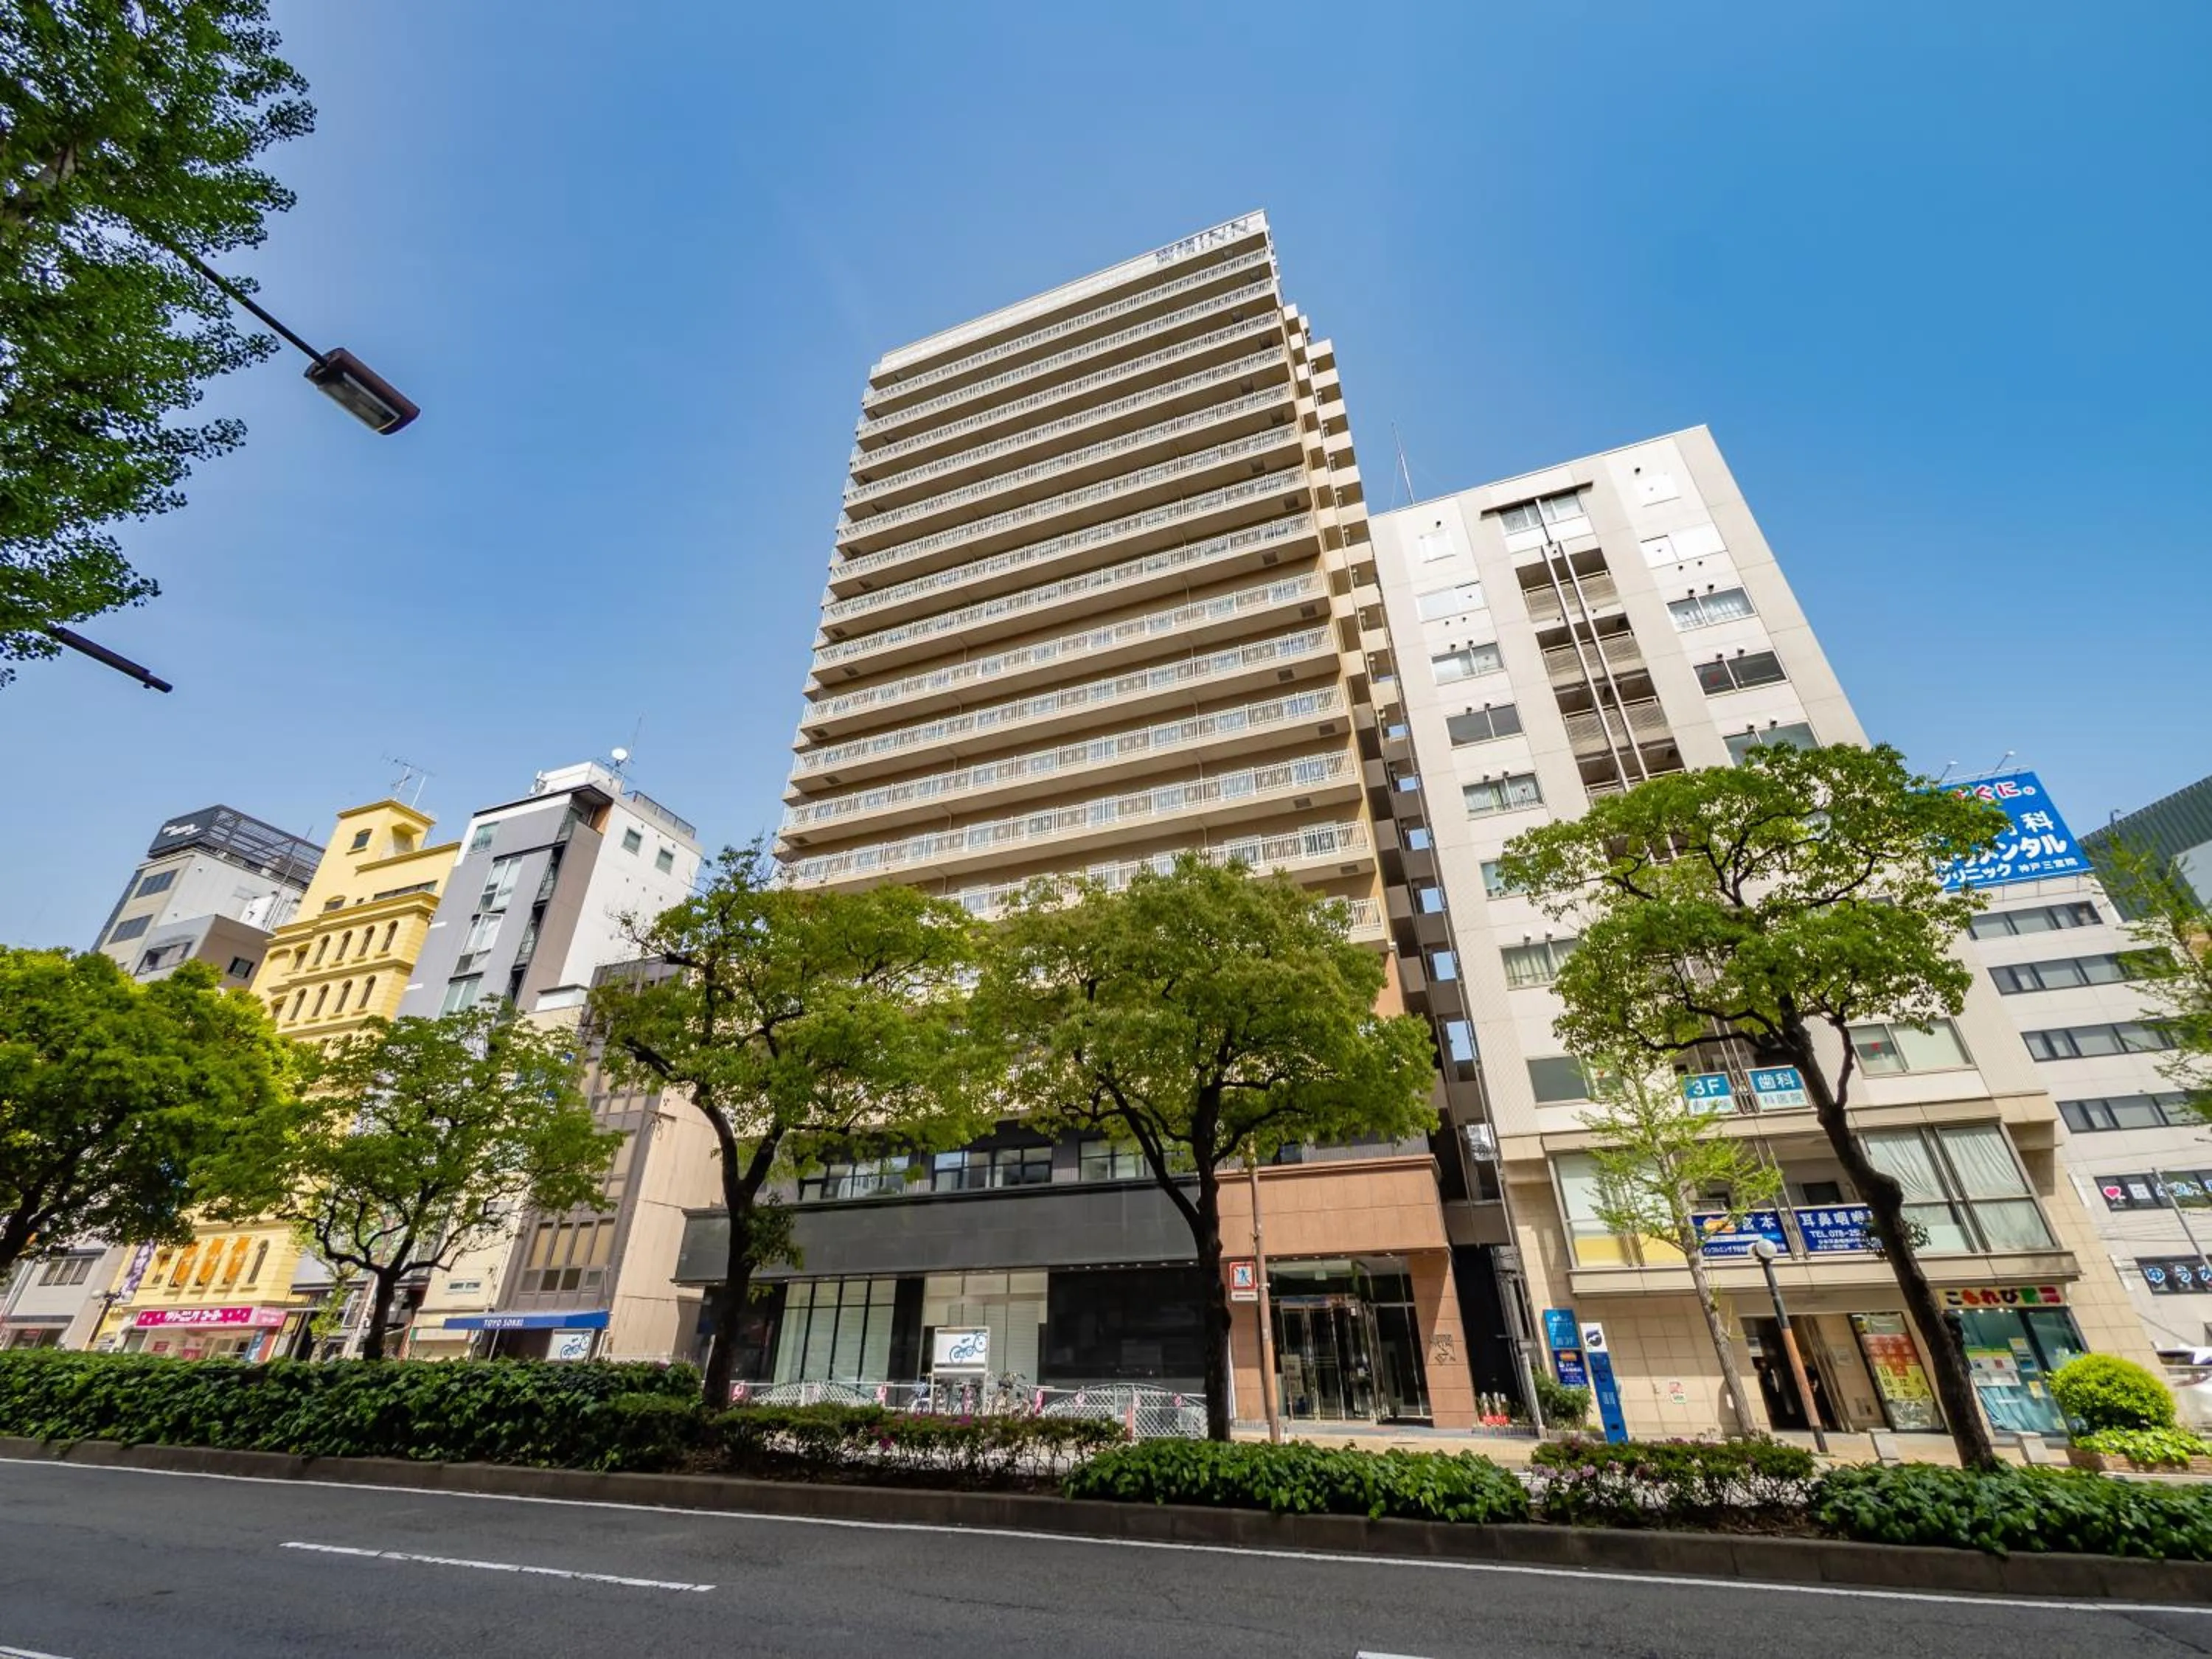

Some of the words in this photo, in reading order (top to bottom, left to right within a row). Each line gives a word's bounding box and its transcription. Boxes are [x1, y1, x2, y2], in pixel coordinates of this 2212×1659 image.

[2017, 858, 2079, 874] 神戸三宮院
[1693, 1078, 1719, 1096] 3F
[1758, 1071, 1795, 1091] 歯科
